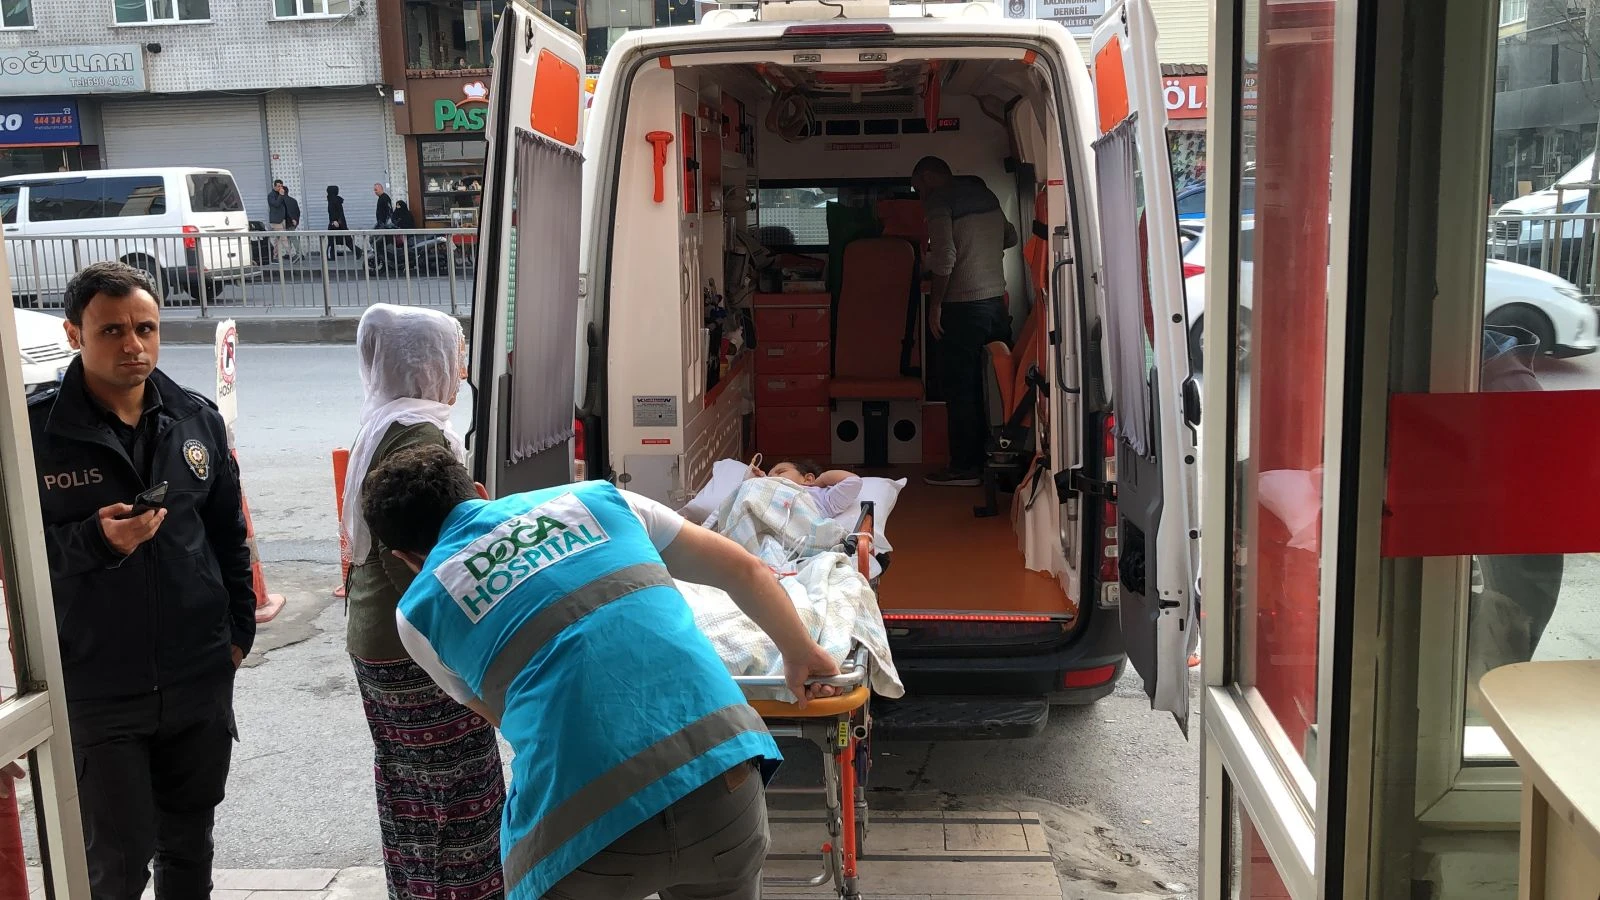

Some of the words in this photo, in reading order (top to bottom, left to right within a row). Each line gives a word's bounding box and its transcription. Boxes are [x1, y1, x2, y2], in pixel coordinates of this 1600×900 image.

[1053, 7, 1088, 16] DERNEĞİ
[0, 51, 134, 75] OĞULLARI
[108, 77, 120, 87] 40
[121, 76, 135, 86] 26
[1164, 80, 1208, 110] ÖL
[463, 515, 568, 582] DOĞA
[462, 524, 602, 616] HOSPITAL
